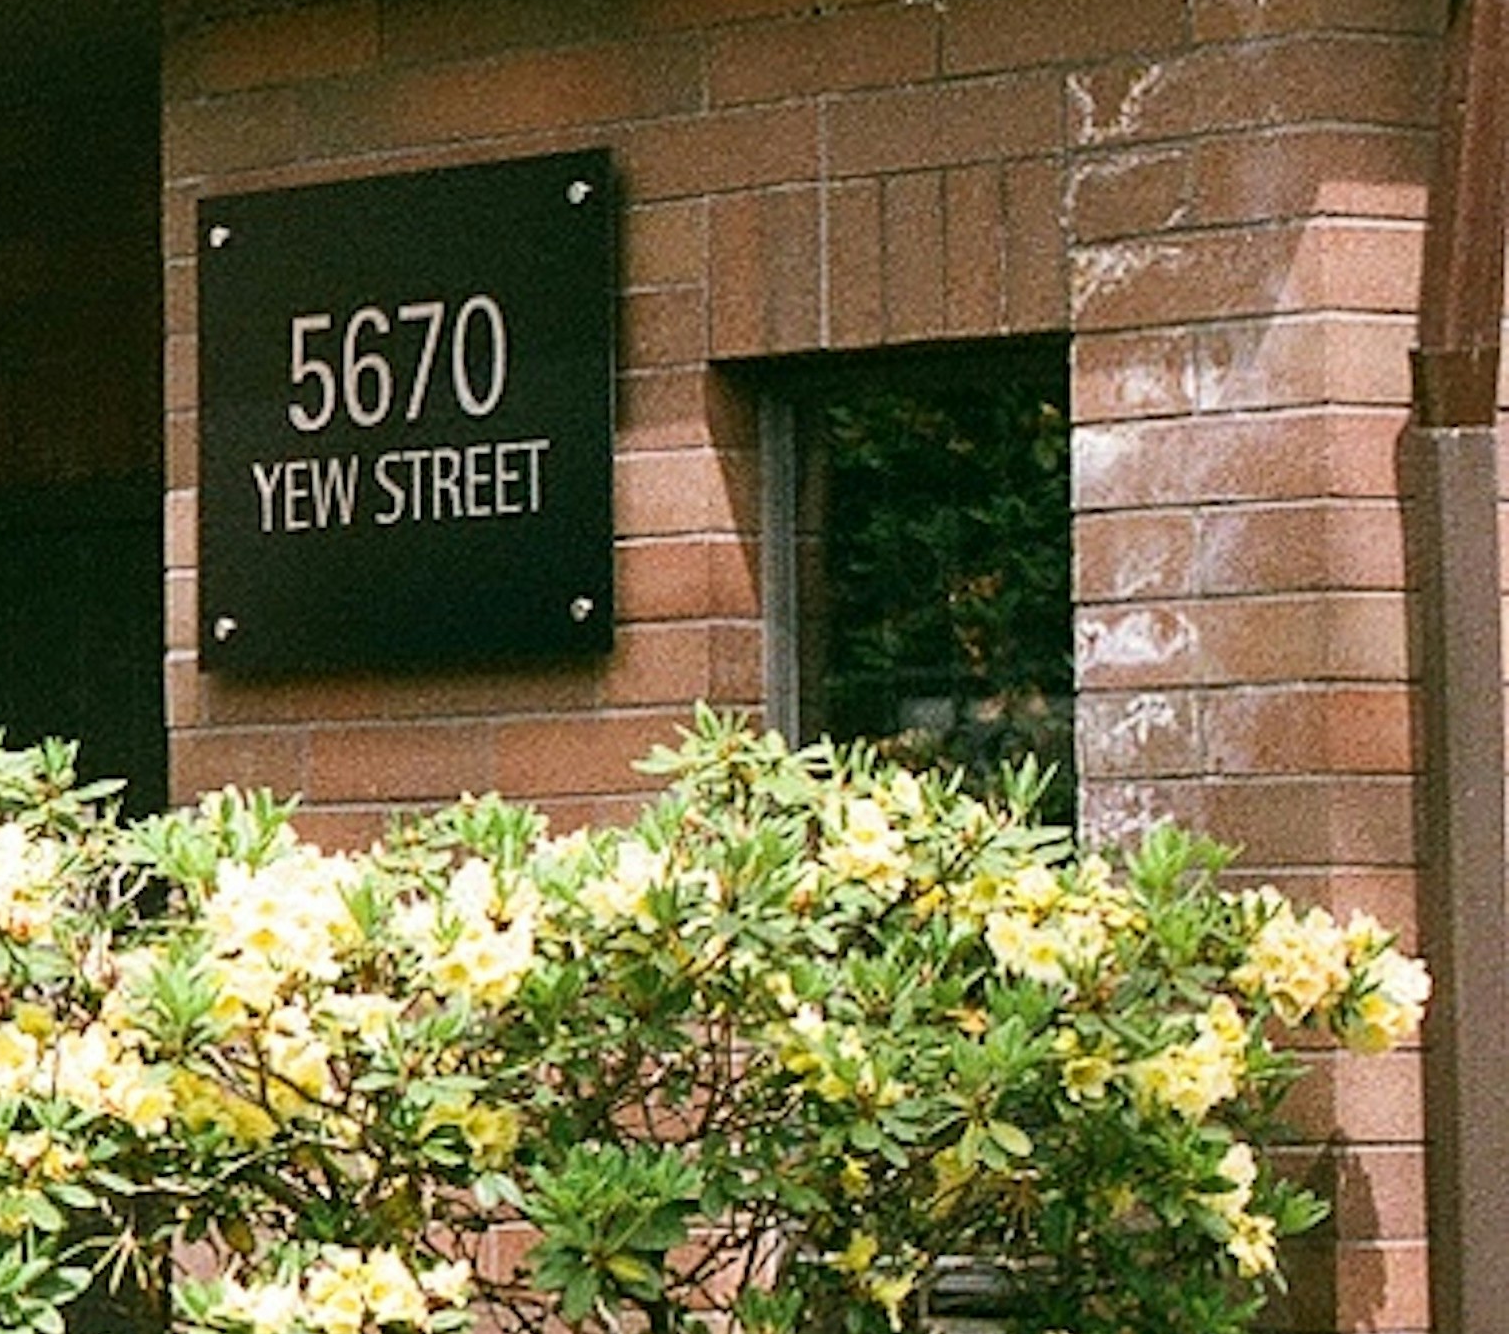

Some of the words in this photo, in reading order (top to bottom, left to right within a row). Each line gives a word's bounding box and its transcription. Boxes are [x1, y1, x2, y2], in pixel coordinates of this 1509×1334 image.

[287, 294, 507, 432] 5670
[251, 454, 360, 533] YEW
[374, 438, 551, 526] STREET
